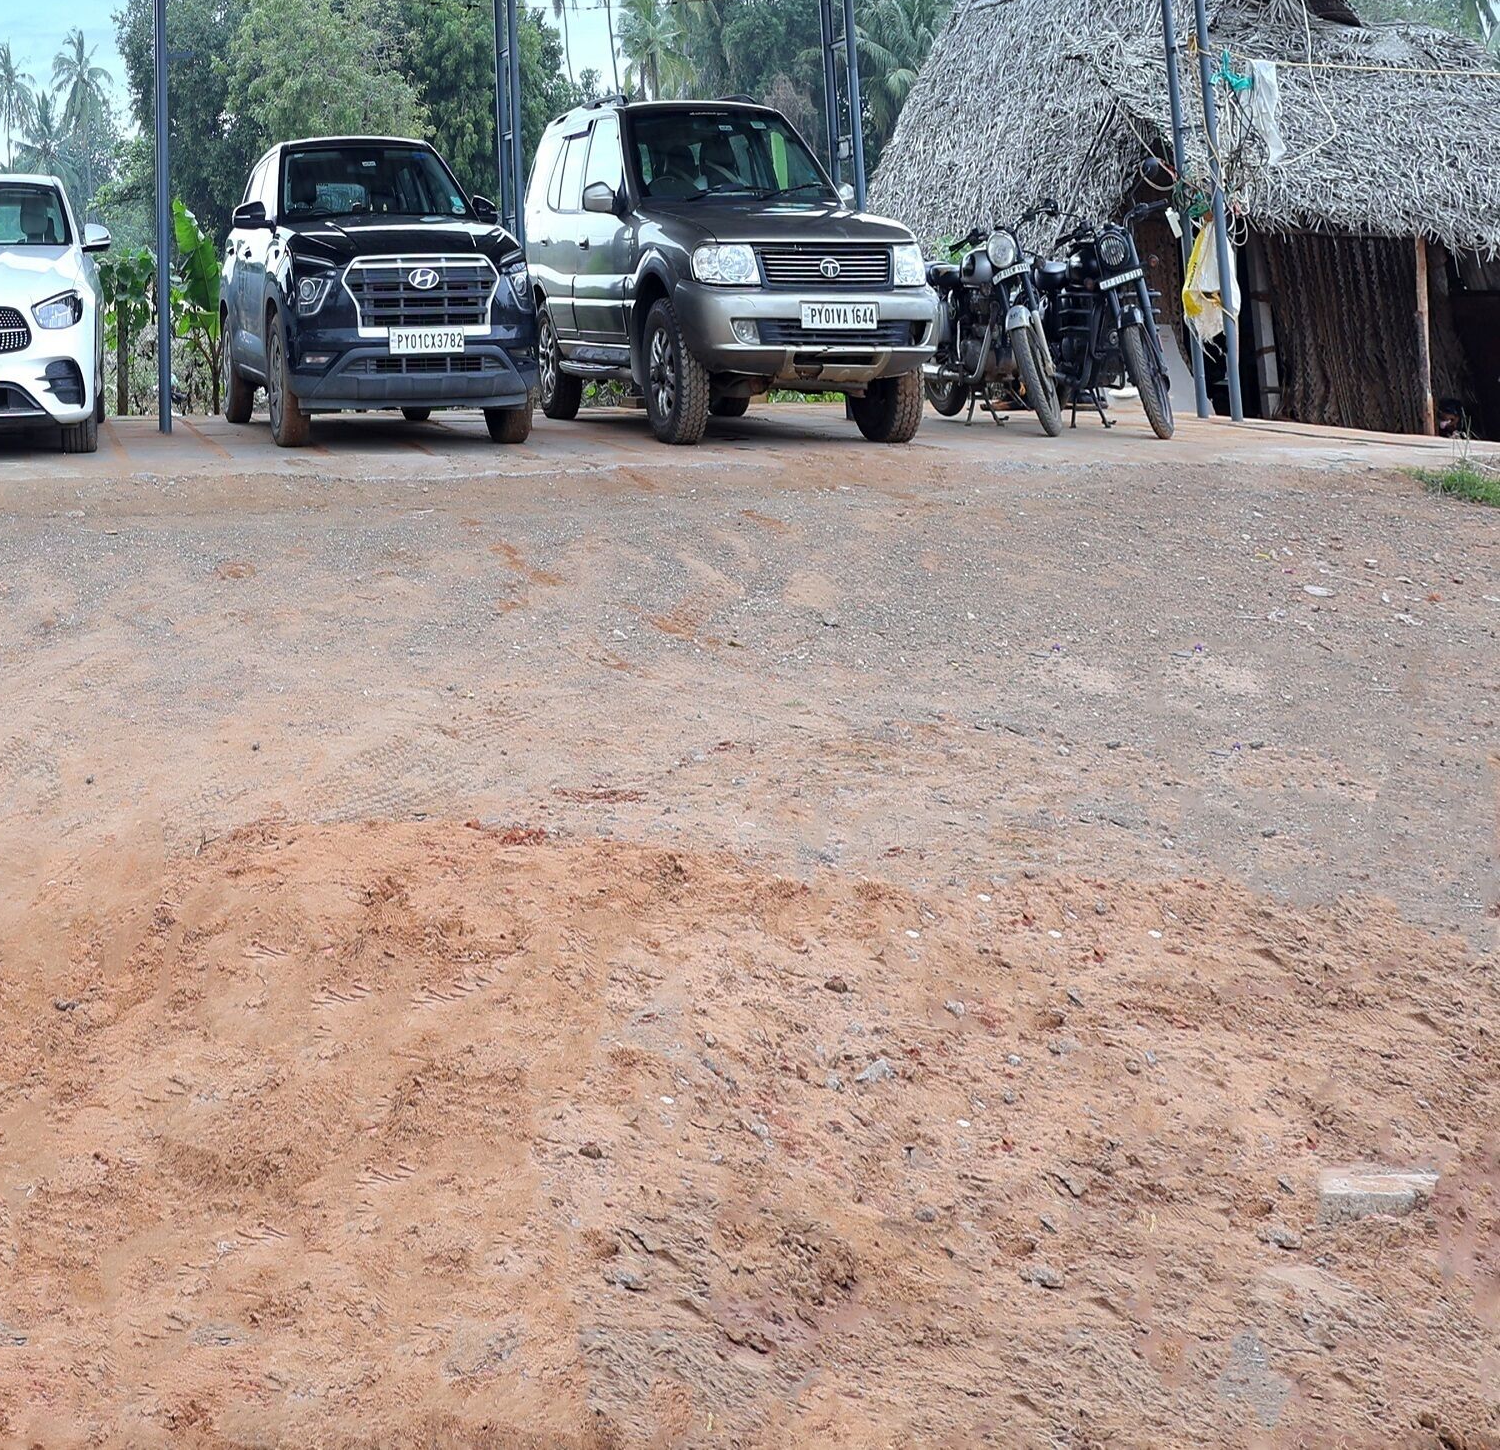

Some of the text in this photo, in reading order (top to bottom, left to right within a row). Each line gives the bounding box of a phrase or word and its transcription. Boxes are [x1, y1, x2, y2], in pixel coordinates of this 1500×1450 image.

[810, 307, 874, 324] PY01VA 1644
[397, 333, 463, 349] PY01CX3782
